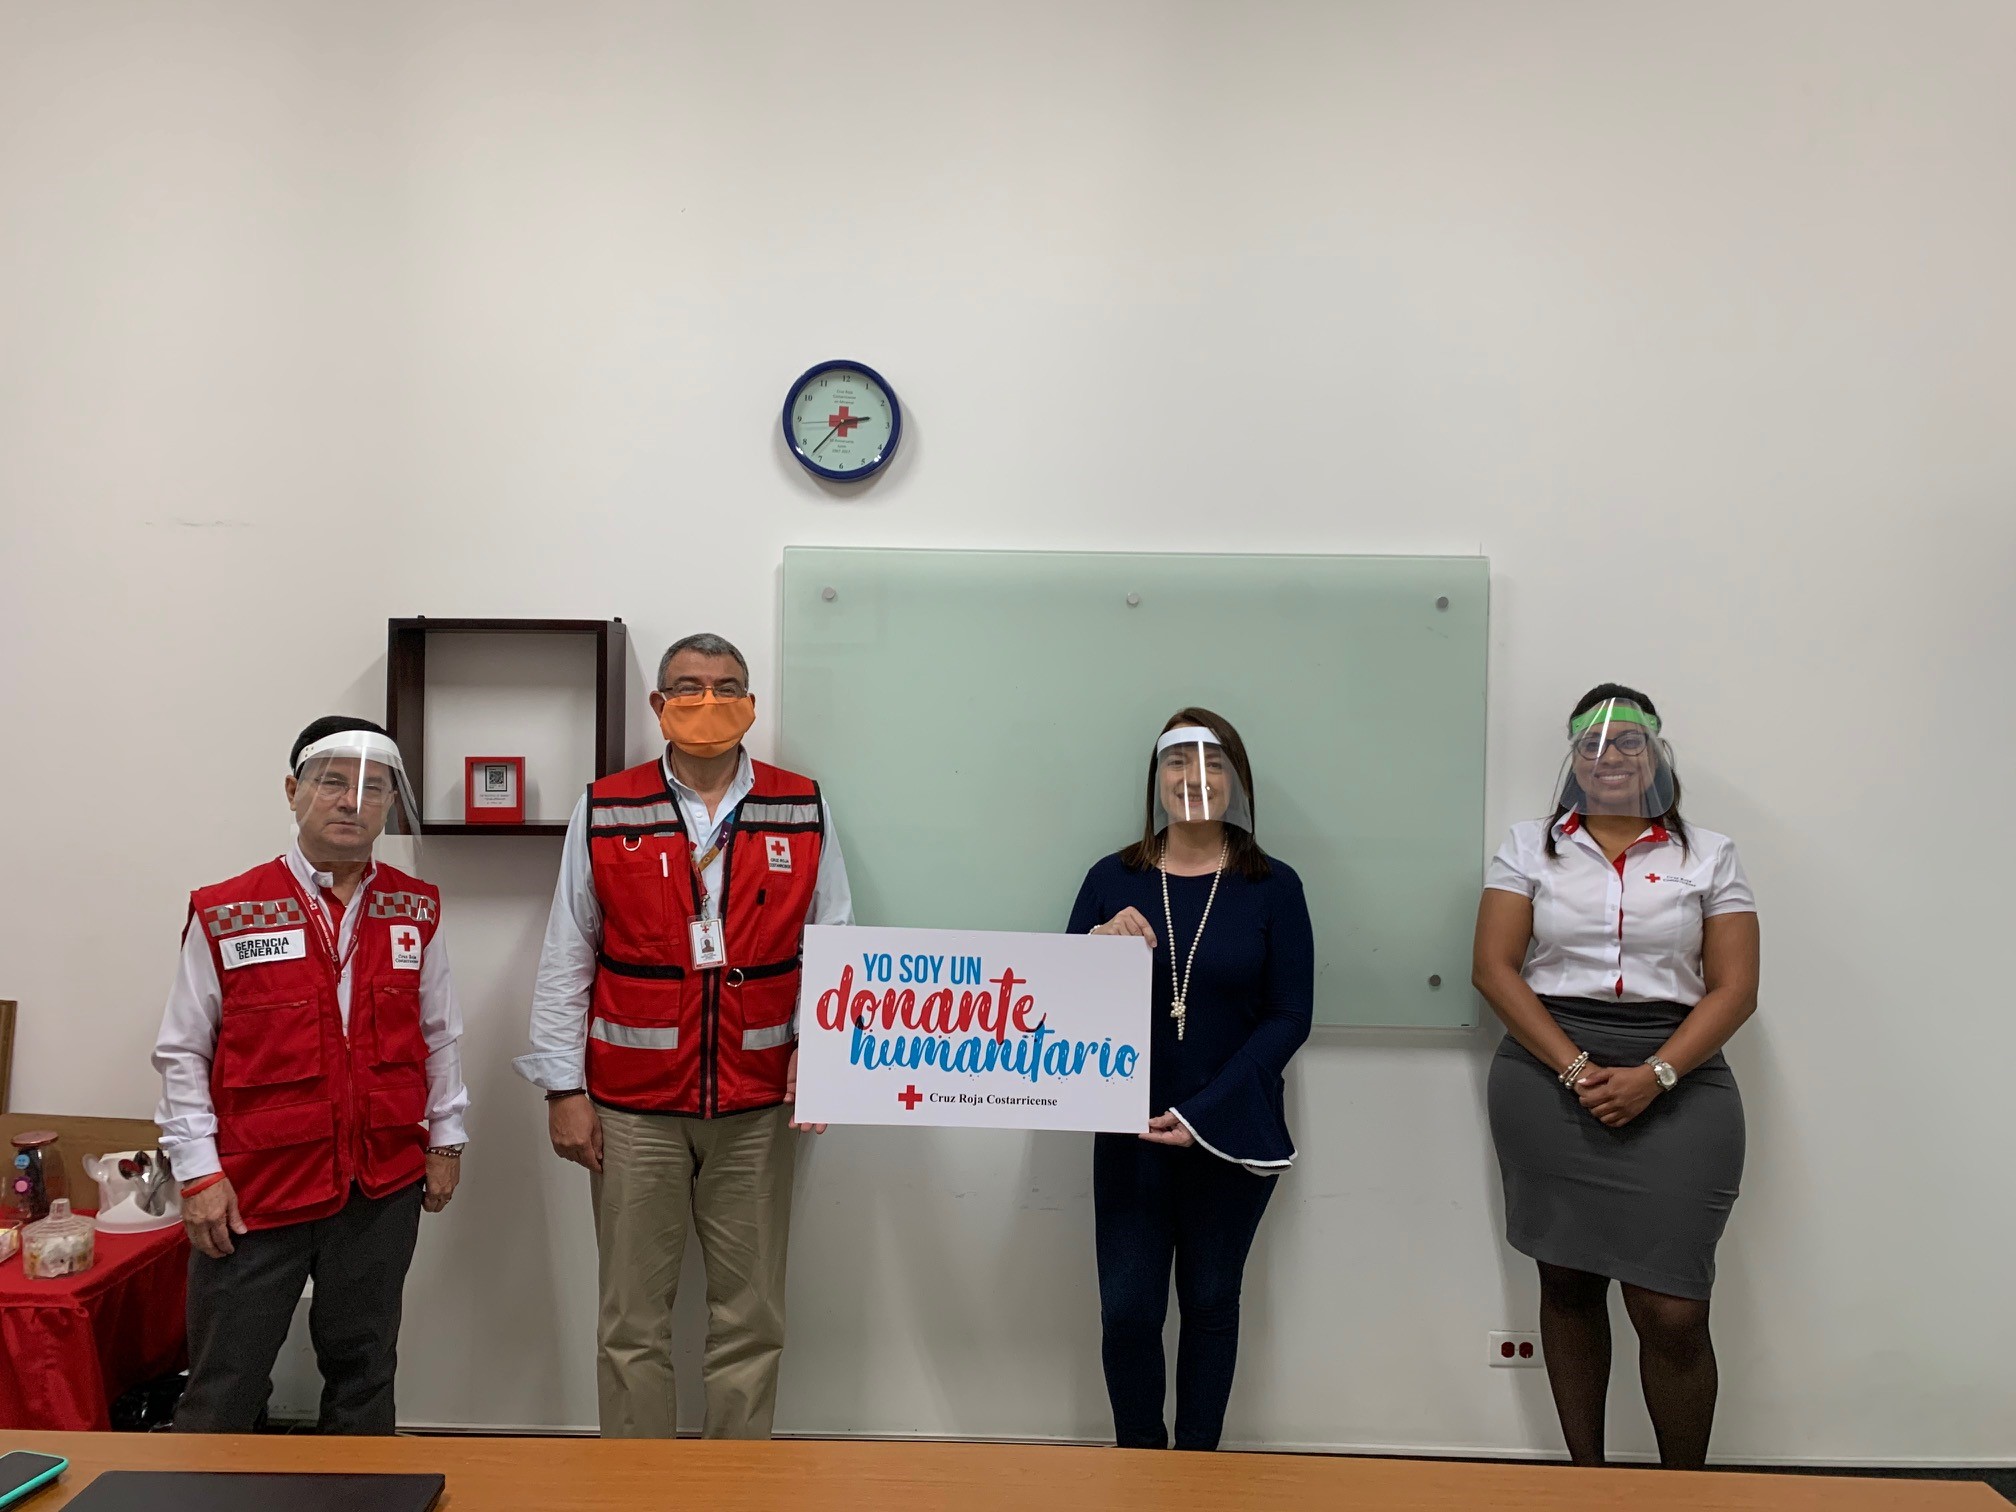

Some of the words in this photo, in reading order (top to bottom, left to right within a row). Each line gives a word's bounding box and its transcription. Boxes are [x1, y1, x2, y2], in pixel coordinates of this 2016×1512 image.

[842, 375, 851, 383] 12
[804, 394, 813, 402] 10
[885, 422, 890, 430] 3
[802, 438, 808, 446] 8
[235, 937, 289, 952] GERENCIA
[238, 946, 288, 960] GENERAL
[863, 953, 892, 982] YO
[899, 954, 944, 984] SOY
[950, 955, 982, 985] UN
[816, 964, 1047, 1045] donante
[850, 1015, 1140, 1083] humanitario
[929, 1092, 956, 1103] Cruz
[959, 1093, 984, 1106] Roja
[986, 1094, 1058, 1106] Costarricense
